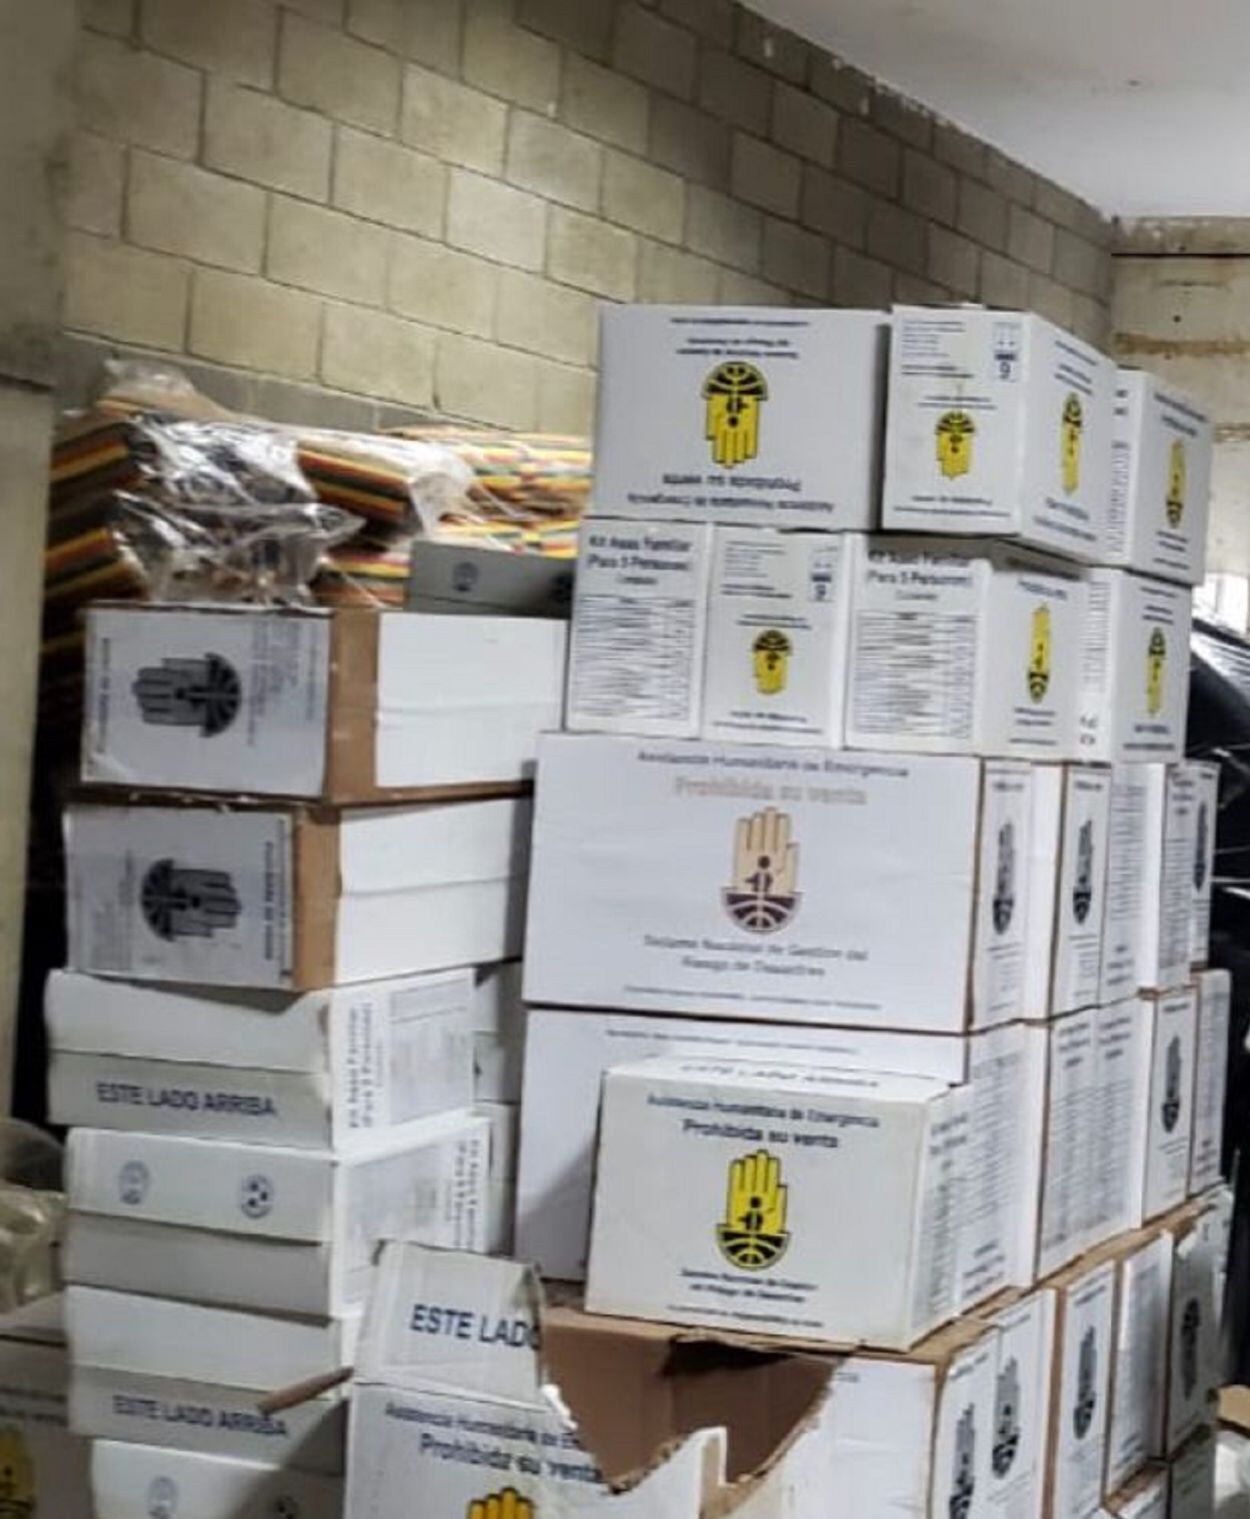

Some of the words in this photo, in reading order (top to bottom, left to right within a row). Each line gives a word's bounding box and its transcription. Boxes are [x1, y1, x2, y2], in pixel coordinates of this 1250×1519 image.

[96, 1081, 144, 1107] ESTE
[147, 1087, 200, 1112] LADO
[203, 1091, 278, 1117] ARRIBA
[683, 1117, 764, 1142] Prohibida
[768, 1130, 789, 1144] su
[793, 1132, 839, 1148] venta
[410, 1303, 475, 1340] ESTE
[112, 1394, 159, 1420] ESTE
[163, 1404, 213, 1428] LADO
[218, 1408, 288, 1436] ARRIBA
[517, 1455, 541, 1476] su
